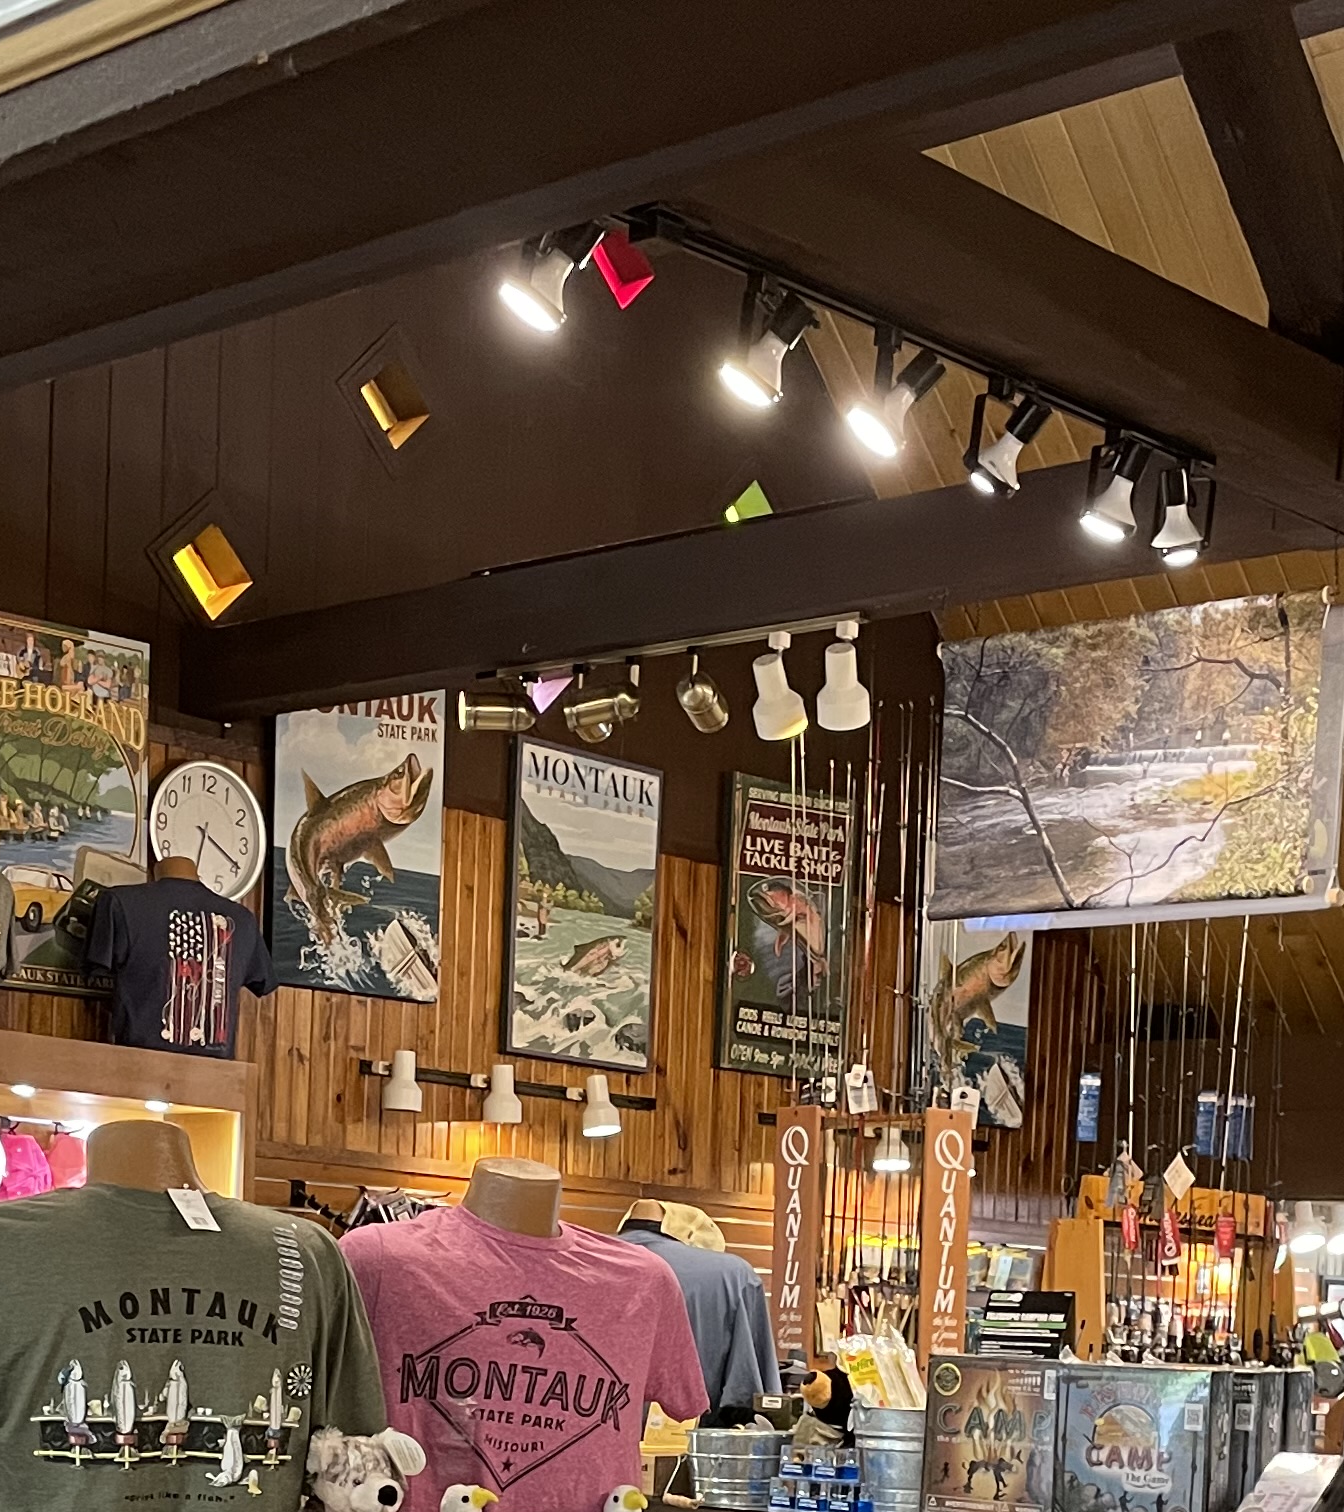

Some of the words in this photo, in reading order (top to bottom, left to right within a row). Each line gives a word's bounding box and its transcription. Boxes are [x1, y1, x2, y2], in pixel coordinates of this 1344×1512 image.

[22, 680, 147, 752] HOLLAND
[377, 723, 407, 742] STATE
[411, 728, 438, 743] PARK
[182, 774, 192, 794] 11
[201, 773, 217, 794] 12
[528, 751, 654, 808] MONTAUK
[164, 788, 179, 809] 10
[225, 786, 230, 806] 1
[157, 812, 167, 831] 9
[235, 808, 247, 828] 2
[161, 839, 171, 858] 8
[239, 836, 249, 856] 3
[745, 835, 785, 855] LIVE
[789, 842, 831, 862] BAIT
[743, 850, 798, 873] TACKLE
[801, 857, 842, 878] SHOP
[214, 874, 224, 893] 5
[87, 976, 115, 990] PAR
[781, 1124, 811, 1311] QUANTUM
[933, 1128, 967, 1315] QUANTUM
[78, 1287, 278, 1346] MONTAUK
[523, 1305, 558, 1319] 1926
[126, 1327, 182, 1344] STATE
[191, 1329, 244, 1346] PARK
[400, 1353, 630, 1432] MONTAUK
[521, 1413, 566, 1432] PARK
[936, 1402, 1053, 1441] CAMP
[483, 1433, 545, 1453] MISSOURI
[1085, 1443, 1173, 1472] CAMP
